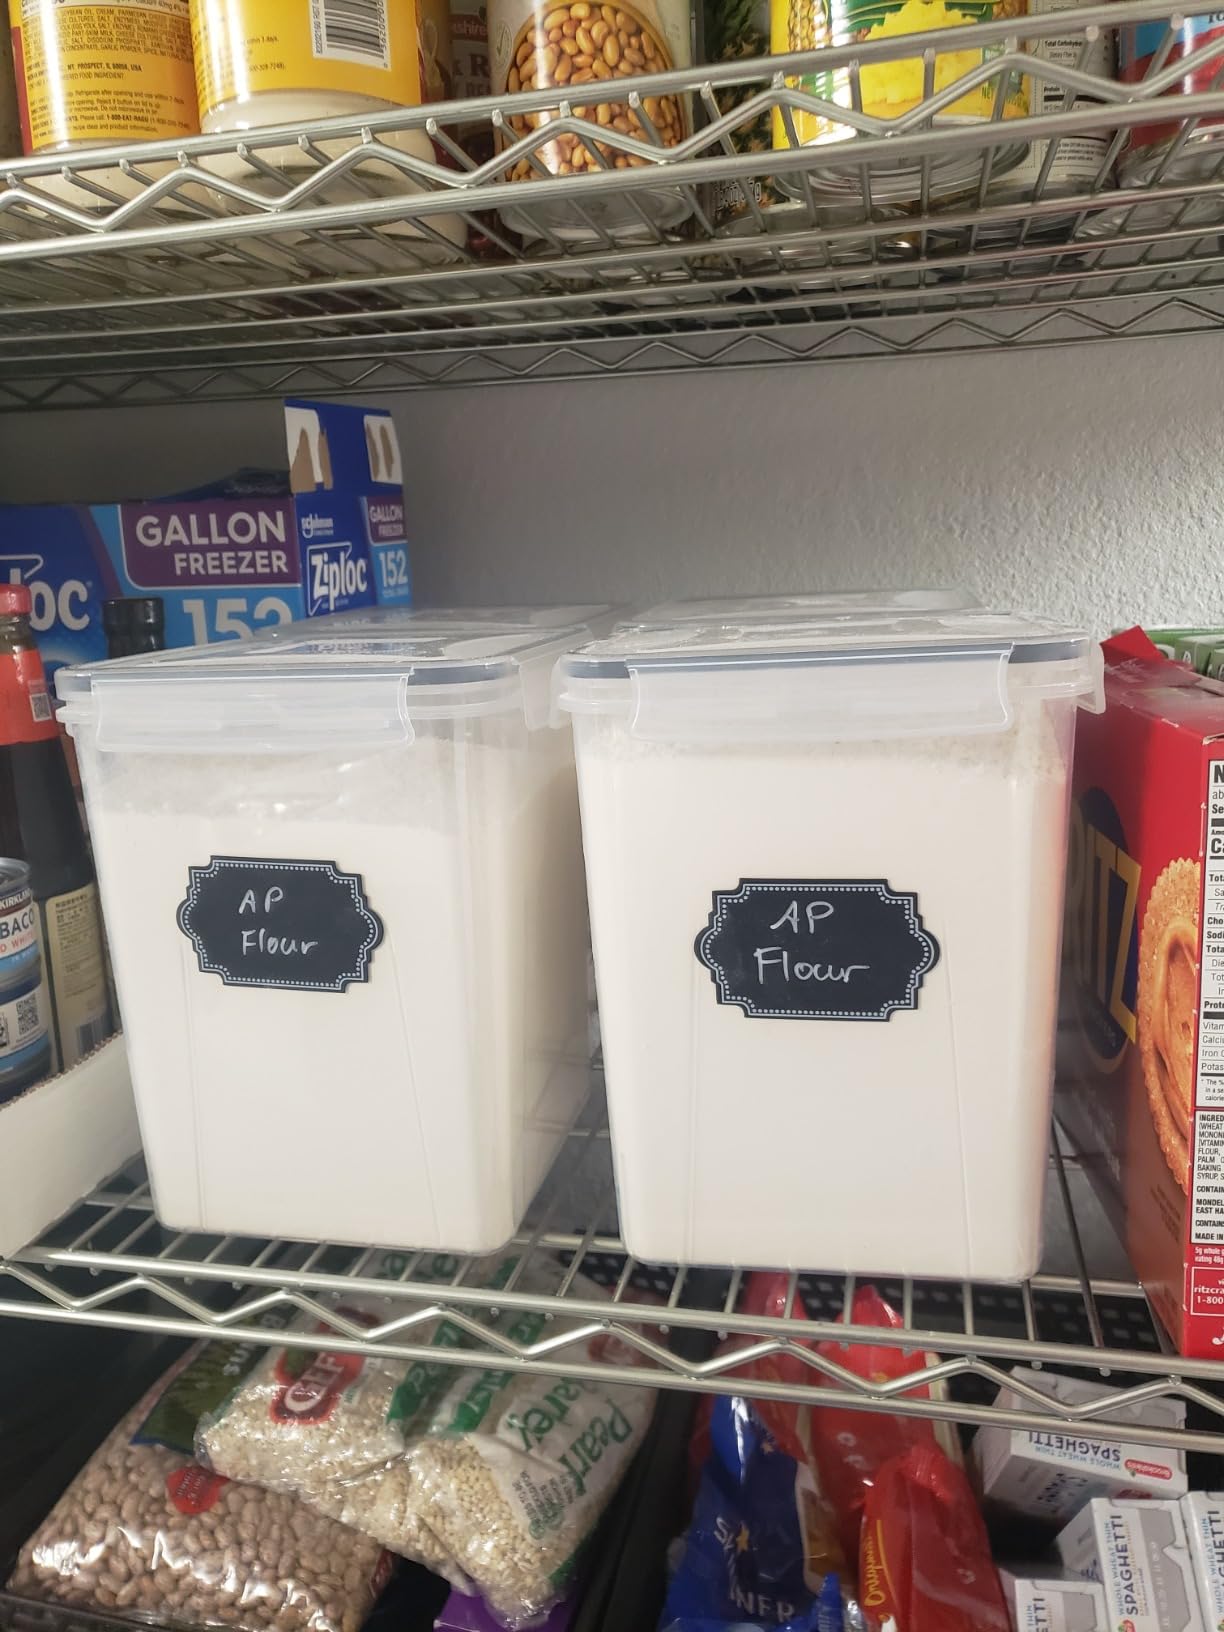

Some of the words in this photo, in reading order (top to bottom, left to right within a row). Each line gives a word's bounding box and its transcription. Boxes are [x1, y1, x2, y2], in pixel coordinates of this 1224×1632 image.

[369, 505, 403, 522] GALLON
[135, 511, 286, 547] GALLON
[174, 550, 288, 576] FREEZER
[378, 549, 409, 588] 152
[311, 551, 368, 611] Ziploc
[238, 886, 284, 914] AP
[770, 900, 834, 933] AP
[241, 928, 318, 955] Flour
[753, 946, 870, 985] Flour
[1201, 1049, 1219, 1057] Iron
[1201, 1062, 1224, 1071] Potas
[1197, 1148, 1221, 1157] FLOUR,
[1197, 1156, 1216, 1164] PALM
[1196, 1164, 1222, 1172] BAKING
[1195, 1206, 1214, 1214] EAST
[1194, 1232, 1215, 1241] MADE
[557, 1397, 632, 1496] Pearl
[1028, 1431, 1121, 1462] SPAGHETTI
[1110, 1515, 1139, 1615] SPAGHETTI
